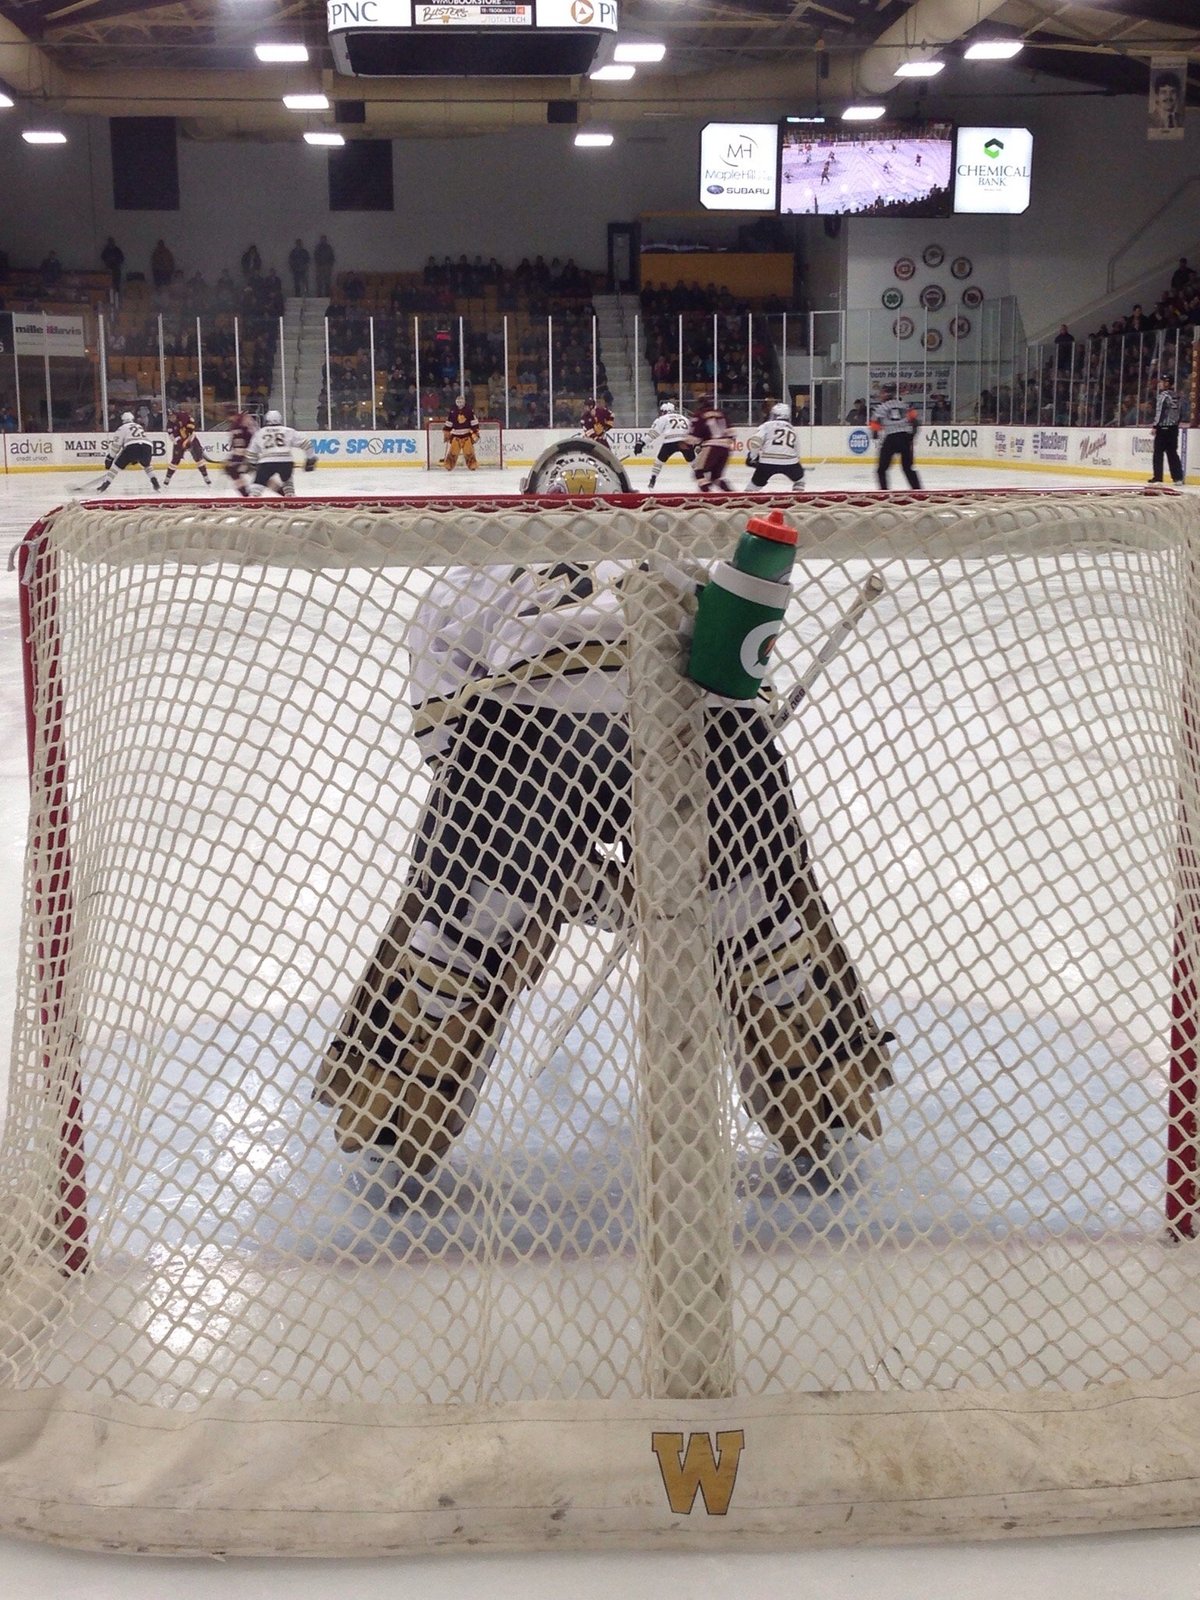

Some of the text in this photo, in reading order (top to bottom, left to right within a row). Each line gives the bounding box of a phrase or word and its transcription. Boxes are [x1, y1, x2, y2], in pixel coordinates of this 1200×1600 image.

[331, 1, 378, 24] PNC
[957, 164, 1030, 178] CHEMICAL
[978, 177, 1007, 187] BANK
[726, 187, 770, 195] SUBARU
[64, 440, 97, 450] MAIN
[926, 429, 978, 447] ARBOR
[10, 439, 53, 454] advia
[651, 1429, 745, 1516] W
